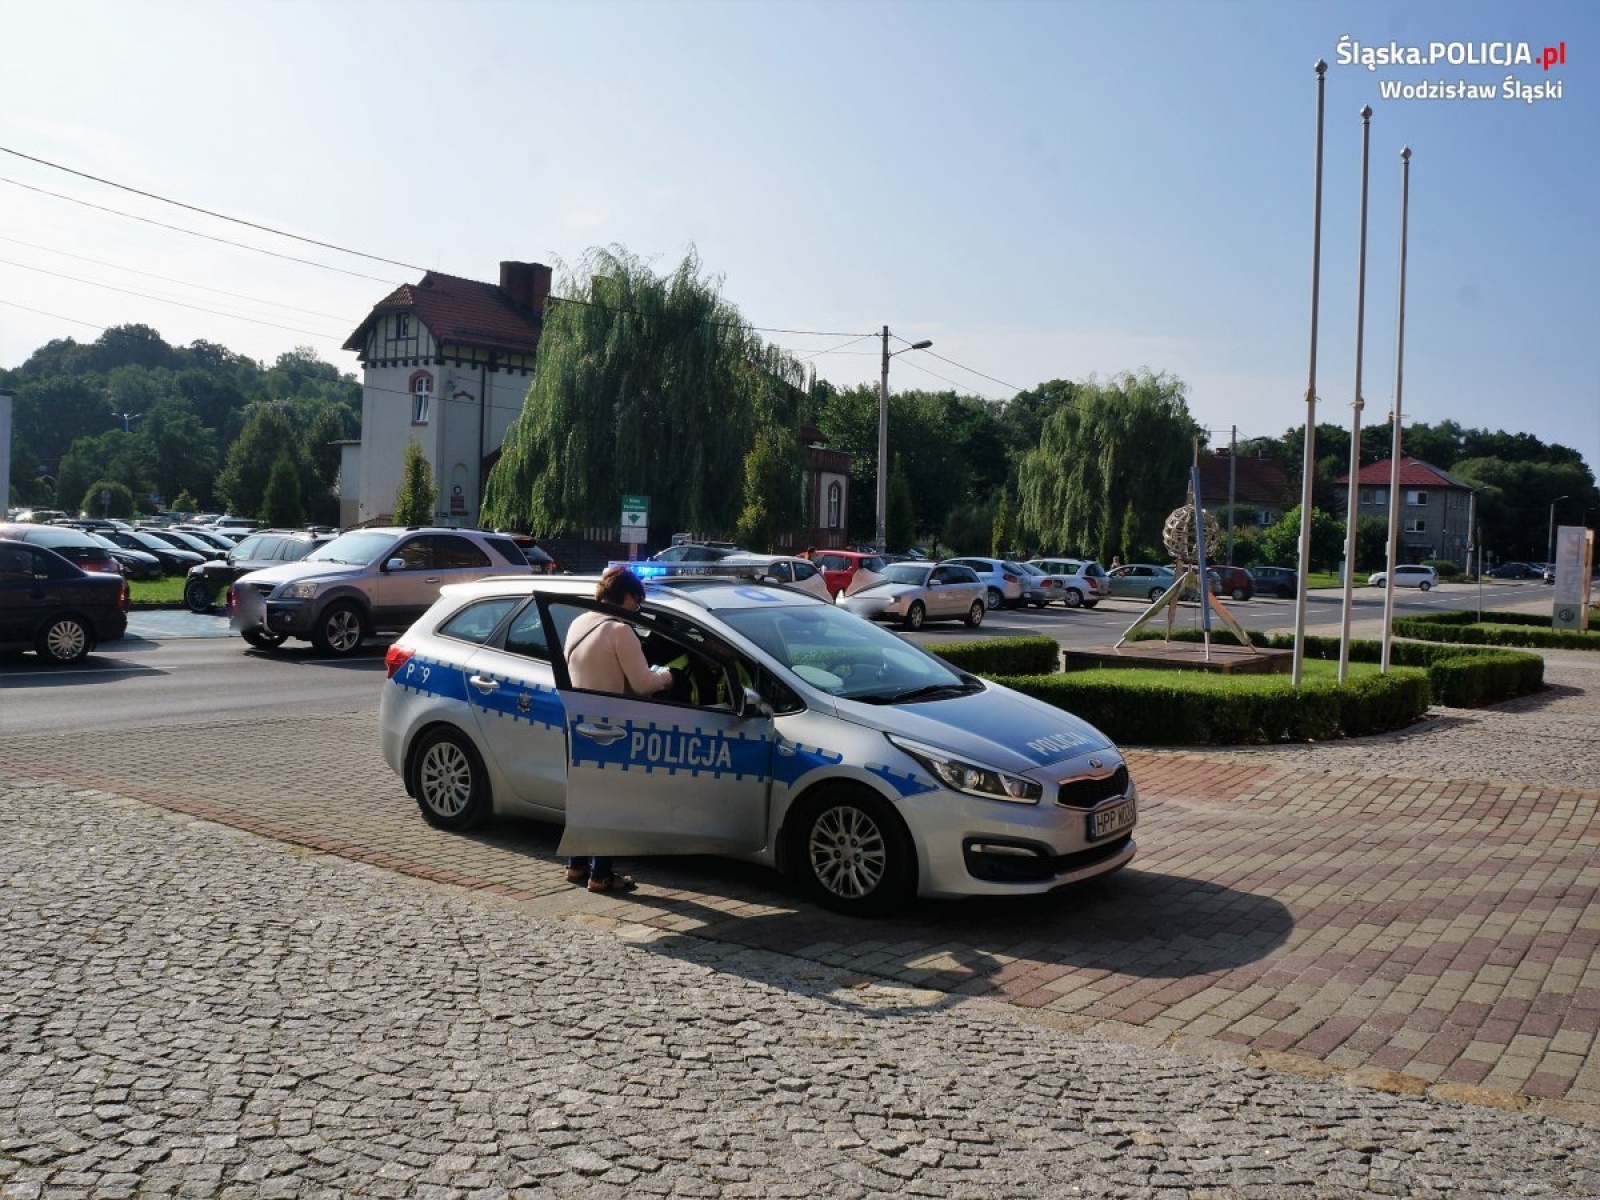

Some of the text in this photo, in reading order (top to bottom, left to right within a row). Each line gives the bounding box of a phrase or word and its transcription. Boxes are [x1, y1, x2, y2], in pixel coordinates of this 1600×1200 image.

[630, 731, 732, 769] POLICJA
[1026, 731, 1090, 756] POLICJA
[1096, 810, 1116, 834] HPP
